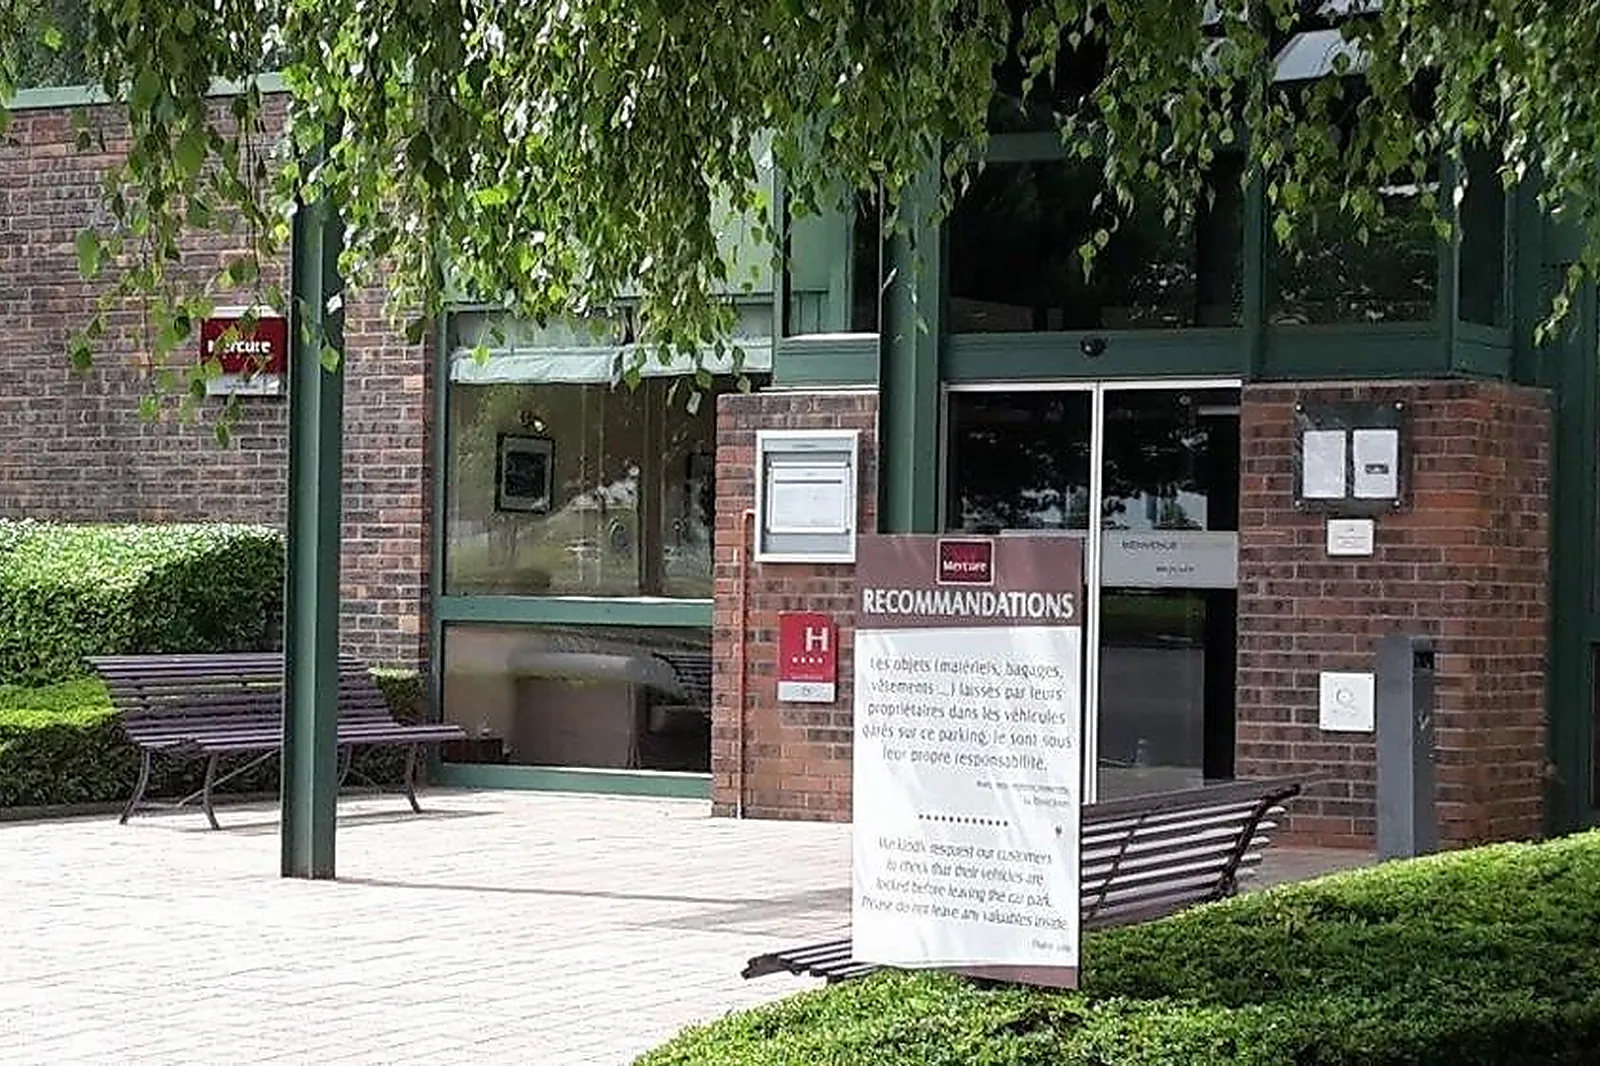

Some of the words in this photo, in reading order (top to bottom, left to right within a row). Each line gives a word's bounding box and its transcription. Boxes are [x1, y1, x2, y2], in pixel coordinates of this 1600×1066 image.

[863, 589, 1074, 618] RECOMMANDATIONS
[805, 627, 829, 653] H
[870, 657, 890, 670] Les
[893, 658, 930, 675] objets
[1004, 686, 1025, 701] par
[1029, 686, 1062, 701] leurs
[868, 703, 945, 720] propriétaires
[949, 704, 978, 719] dans
[981, 706, 999, 720] les
[1004, 709, 1065, 724] véhicules
[898, 728, 916, 739] sur
[921, 729, 935, 740] ce
[1010, 733, 1038, 746] sont
[1043, 735, 1073, 748] sous
[883, 748, 905, 760] leur
[911, 750, 951, 766] propre
[977, 848, 993, 858] our
[931, 862, 952, 876] that
[955, 865, 979, 877] their
[981, 867, 1024, 882] vehicles
[1026, 872, 1044, 885] are
[912, 880, 946, 895] before
[948, 882, 986, 903] leaving
[988, 888, 1006, 901] the
[896, 899, 910, 912] do
[931, 903, 960, 917] leave
[962, 908, 980, 921] any
